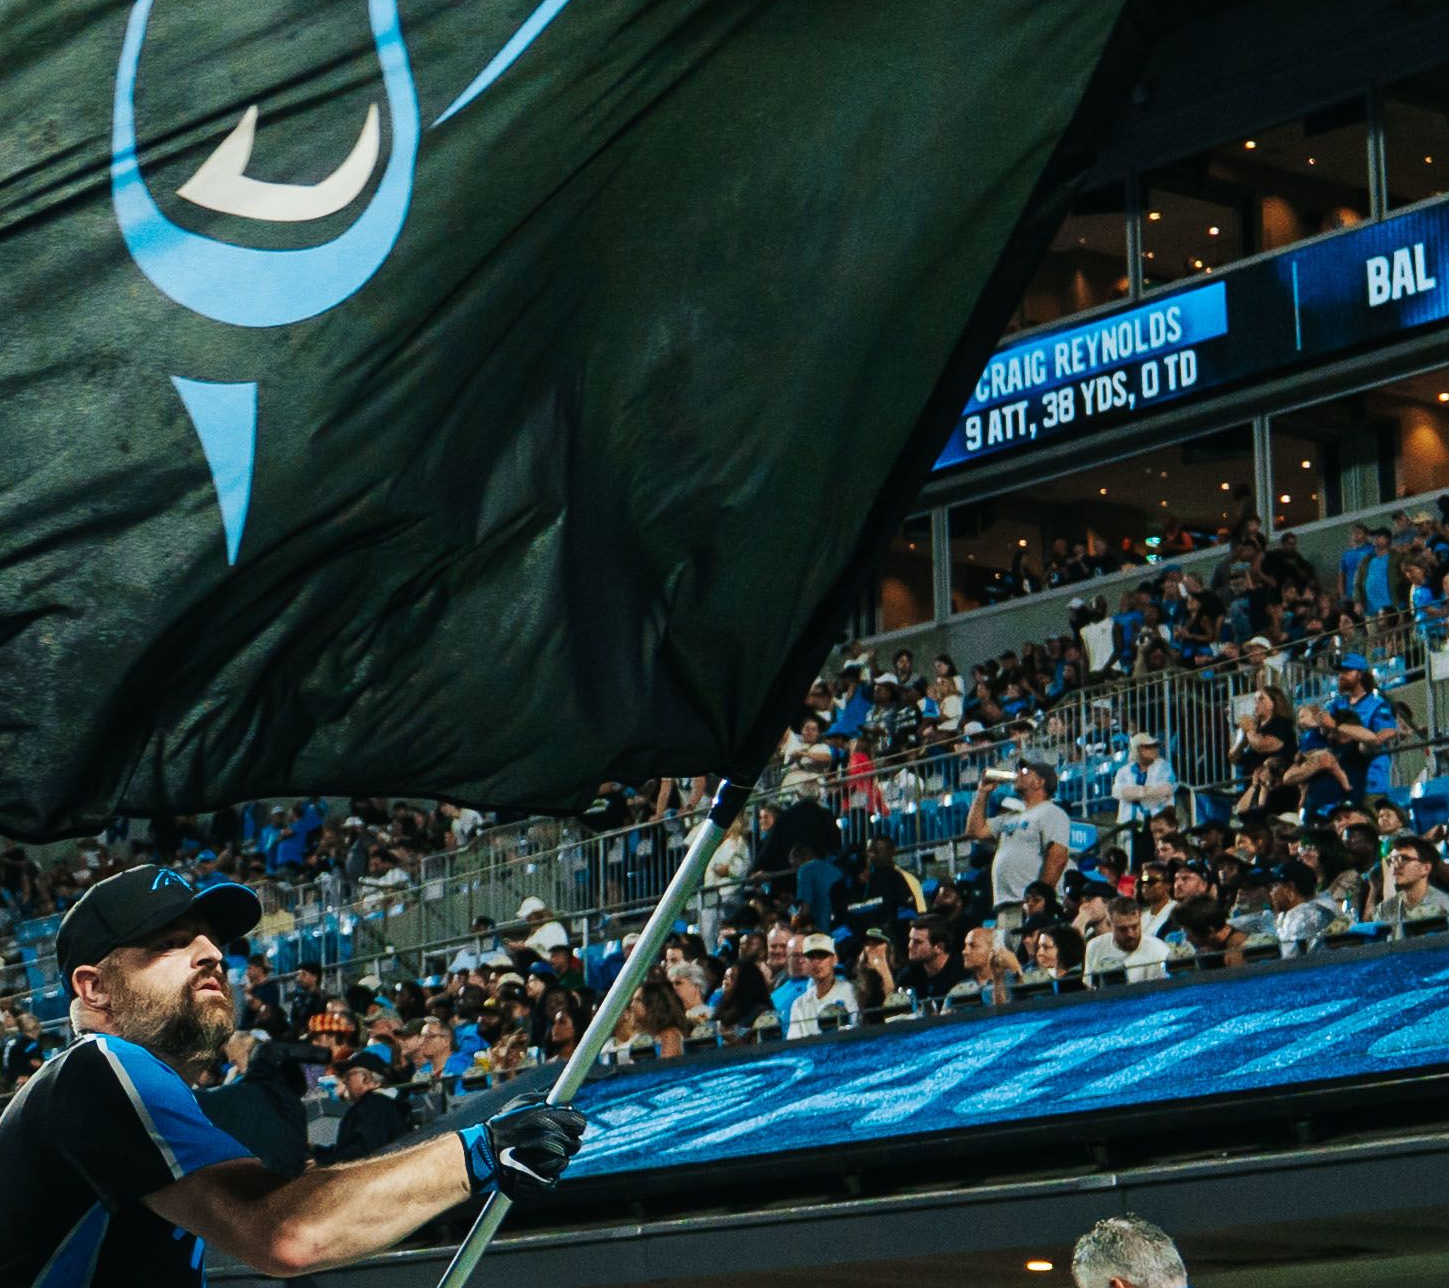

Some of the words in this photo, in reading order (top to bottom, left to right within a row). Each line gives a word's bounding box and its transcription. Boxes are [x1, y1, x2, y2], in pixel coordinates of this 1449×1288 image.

[1366, 242, 1437, 308] BAL
[965, 414, 983, 451] 9
[987, 400, 1036, 446] ATT,
[1042, 386, 1075, 429] 38
[1080, 370, 1135, 417] YDS,
[1142, 361, 1159, 399] 0
[1164, 349, 1198, 392] TD
[975, 349, 1047, 403] CRAIG
[1055, 306, 1182, 378] REYNOLDS
